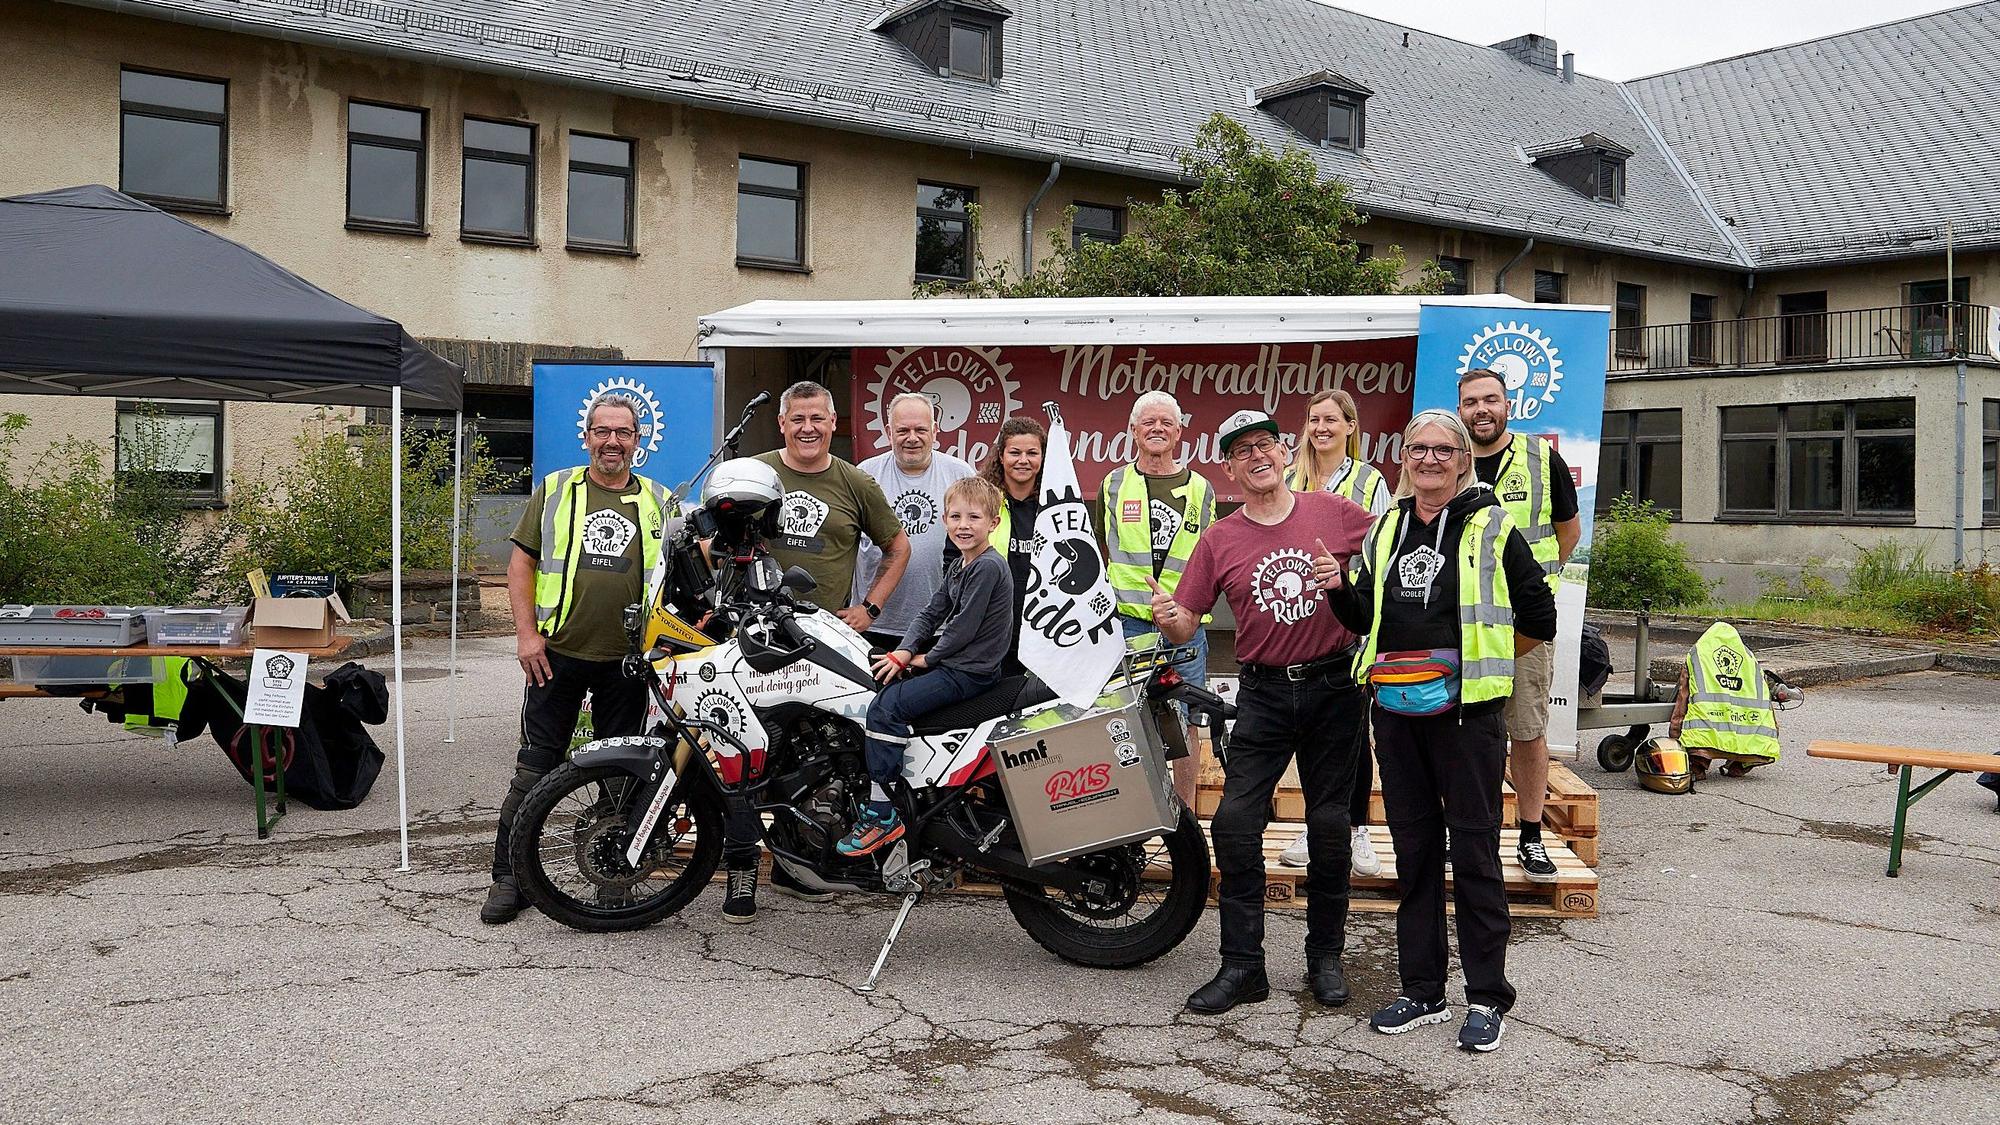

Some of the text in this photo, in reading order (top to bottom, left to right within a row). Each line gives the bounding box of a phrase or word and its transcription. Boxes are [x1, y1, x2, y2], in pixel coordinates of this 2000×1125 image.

[1476, 337, 1546, 367] FELLOWS
[893, 351, 994, 393] FELLOWS
[1050, 344, 1413, 415] Motorradfahren
[1507, 389, 1542, 420] de
[787, 497, 815, 511] FELLOWS
[899, 496, 929, 509] FELLOWS
[1151, 510, 1168, 522] LOWS
[592, 518, 622, 532] FELLOWS
[787, 517, 814, 533] Ride
[591, 537, 620, 553] Ride
[787, 537, 807, 548] EIFEL
[592, 557, 613, 567] EIFEL
[1410, 555, 1434, 566] FELLOWS
[1262, 559, 1311, 584] FELLOWS
[1407, 573, 1428, 586] Ride
[1400, 590, 1425, 598] KOBLEN
[1269, 595, 1317, 626] Ride
[660, 616, 694, 642] TOURATECH
[745, 680, 765, 694] and
[766, 679, 794, 694] doing
[795, 673, 820, 693] good
[702, 697, 735, 713] FELLOWS
[1001, 739, 1048, 769] hmf
[1045, 763, 1112, 803] RMS
[1268, 886, 1287, 898] EPAL
[1568, 896, 1589, 908] EPAL
